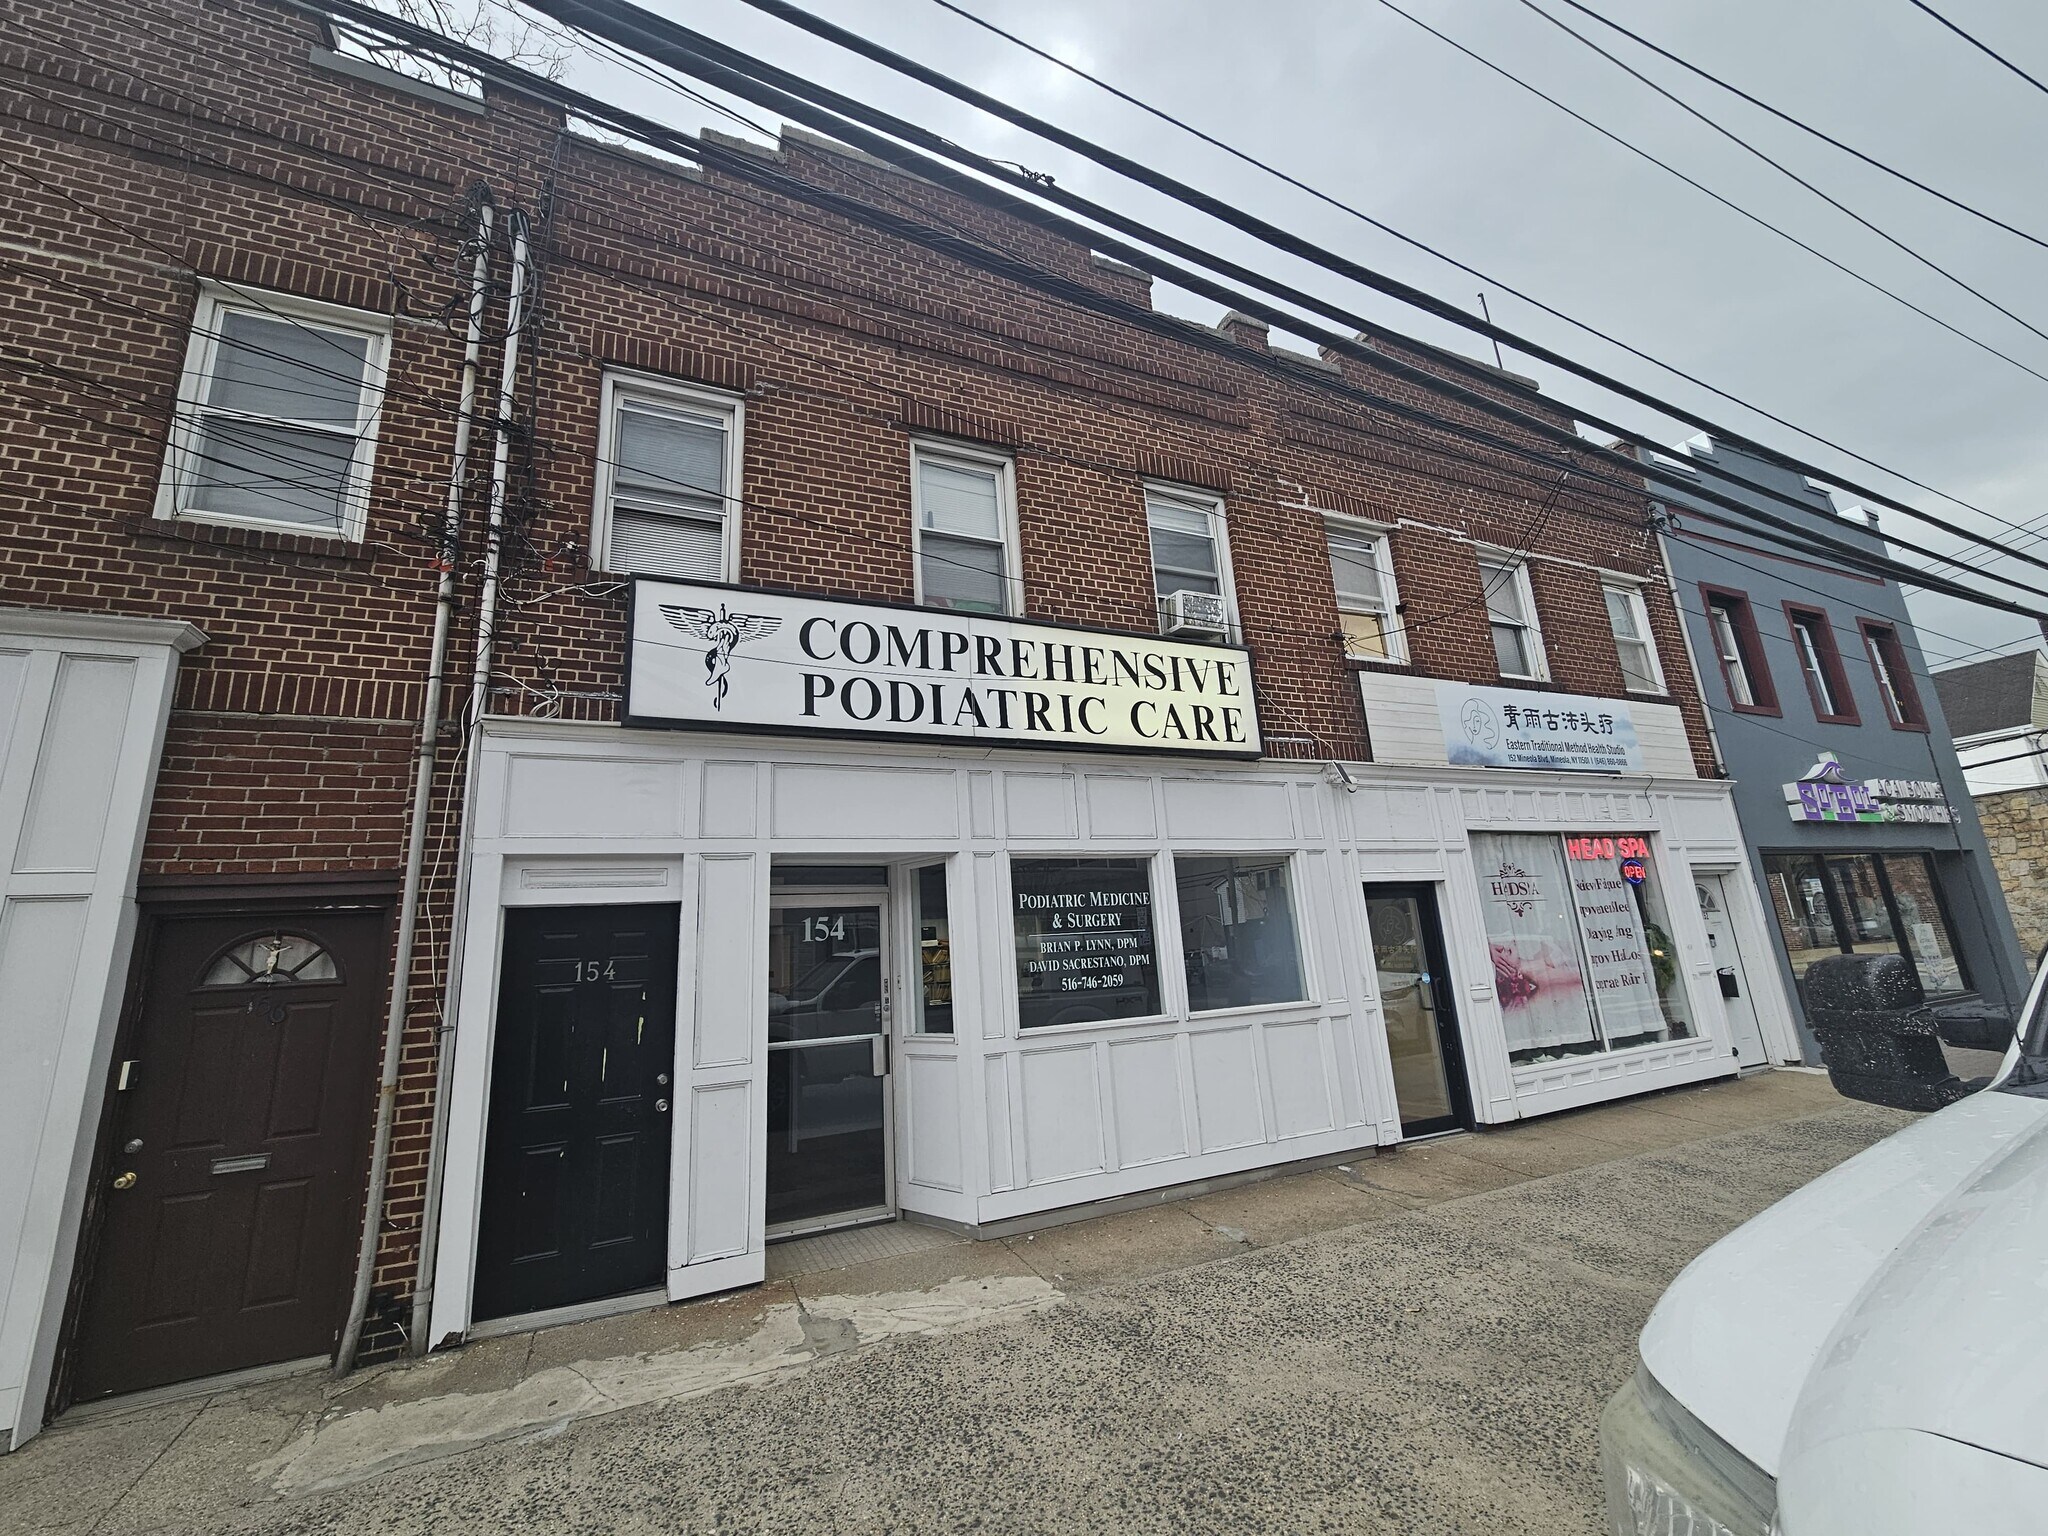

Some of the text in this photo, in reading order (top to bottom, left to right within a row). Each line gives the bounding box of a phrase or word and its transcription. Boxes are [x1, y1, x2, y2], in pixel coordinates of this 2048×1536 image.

[798, 616, 1240, 697] COMPREHENSIVE
[799, 672, 1247, 743] PODIATRIC CARE
[1503, 704, 1613, 735] 青雨古法头疗
[1505, 738, 1626, 755] Eastern Traditional Method Health Studio
[1517, 754, 1537, 763] Mineola
[1570, 756, 1578, 764] NY
[1567, 837, 1650, 860] HEAD SPA
[1624, 865, 1647, 879] OPEN
[1019, 891, 1151, 909] PODIATRIC MEDICINE
[801, 915, 846, 943] 154
[1052, 913, 1063, 929] &
[1067, 912, 1122, 928] SURGERY
[1040, 937, 1138, 954] BRIAN P. LYNN, DPM
[574, 960, 617, 983] 154
[1029, 954, 1150, 973] DAVID SACRESTANO, DPM
[1061, 973, 1124, 991] 516-746-2059
